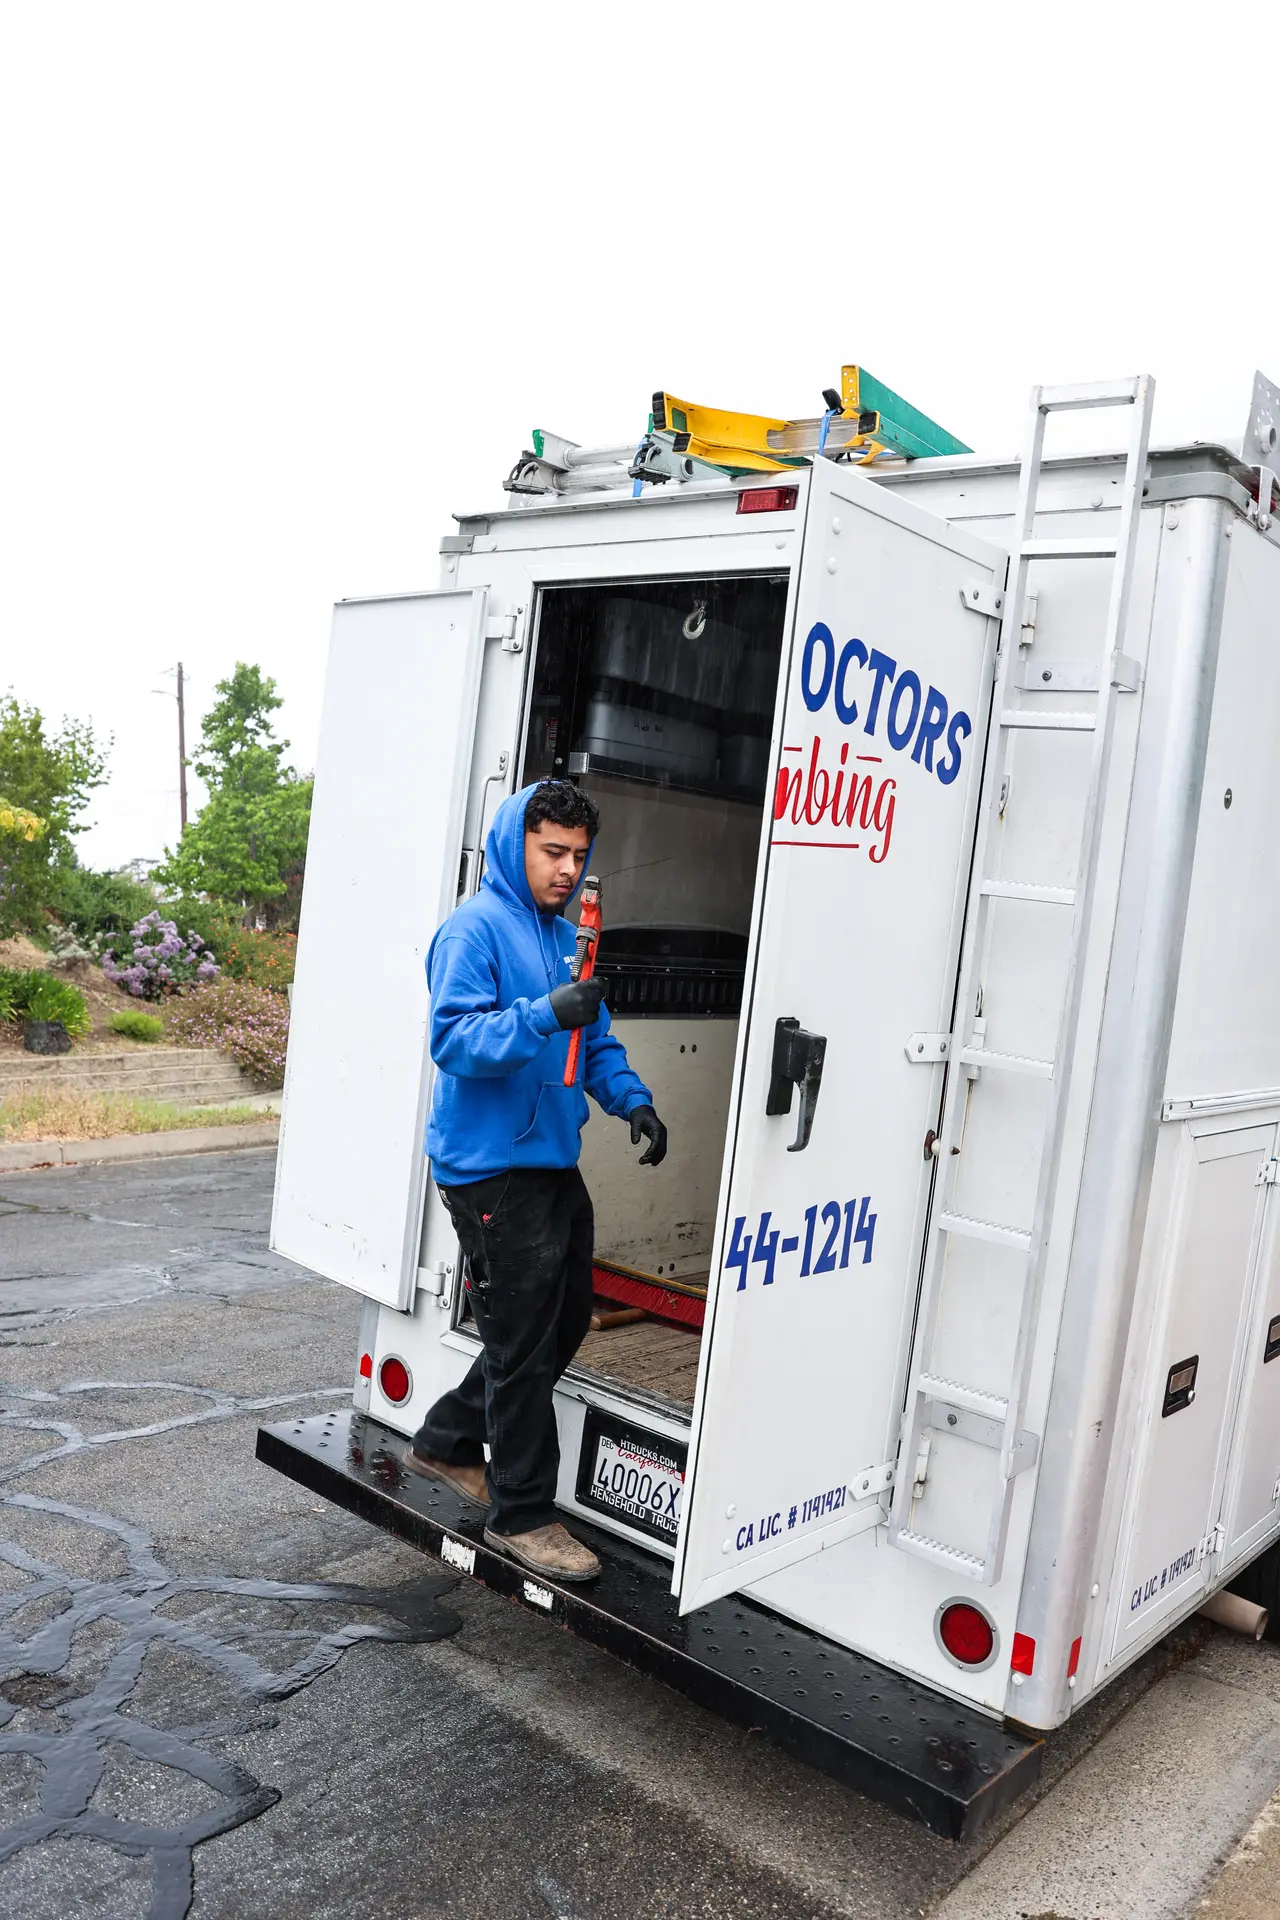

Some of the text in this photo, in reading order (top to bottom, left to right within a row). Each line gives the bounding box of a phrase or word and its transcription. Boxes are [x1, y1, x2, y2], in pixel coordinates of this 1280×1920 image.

[801, 622, 972, 785] OCTORS
[724, 1196, 878, 1292] 44-1214
[601, 1438, 614, 1450] DEC
[620, 1439, 678, 1470] HTRUCKS.COM
[590, 1484, 646, 1519] HENGEHOLD
[597, 1458, 681, 1519] 40006X
[736, 1523, 754, 1551] CA
[758, 1512, 782, 1542] LIC.
[788, 1505, 798, 1530] #
[1130, 1586, 1142, 1611] CA
[1143, 1575, 1158, 1602] LIC.
[1160, 1568, 1168, 1590] #
